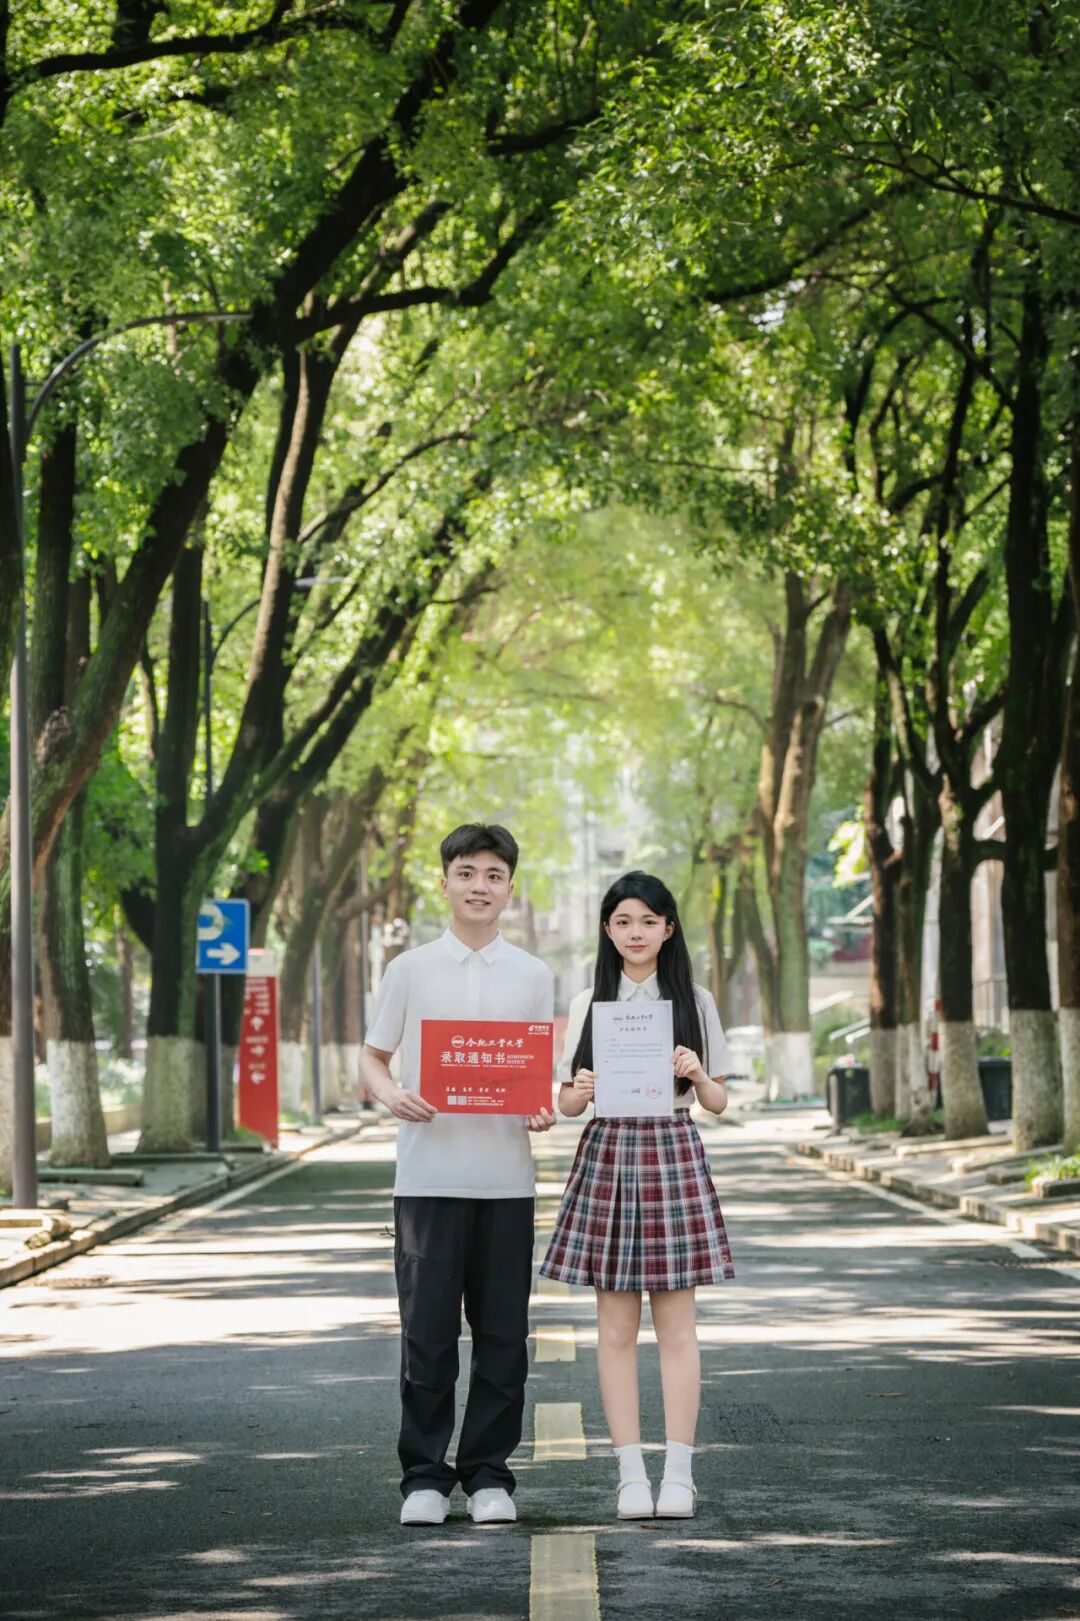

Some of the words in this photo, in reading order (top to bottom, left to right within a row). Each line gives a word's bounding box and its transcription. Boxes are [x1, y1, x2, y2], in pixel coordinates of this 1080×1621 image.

[441, 1051, 506, 1064] 录取通知书
